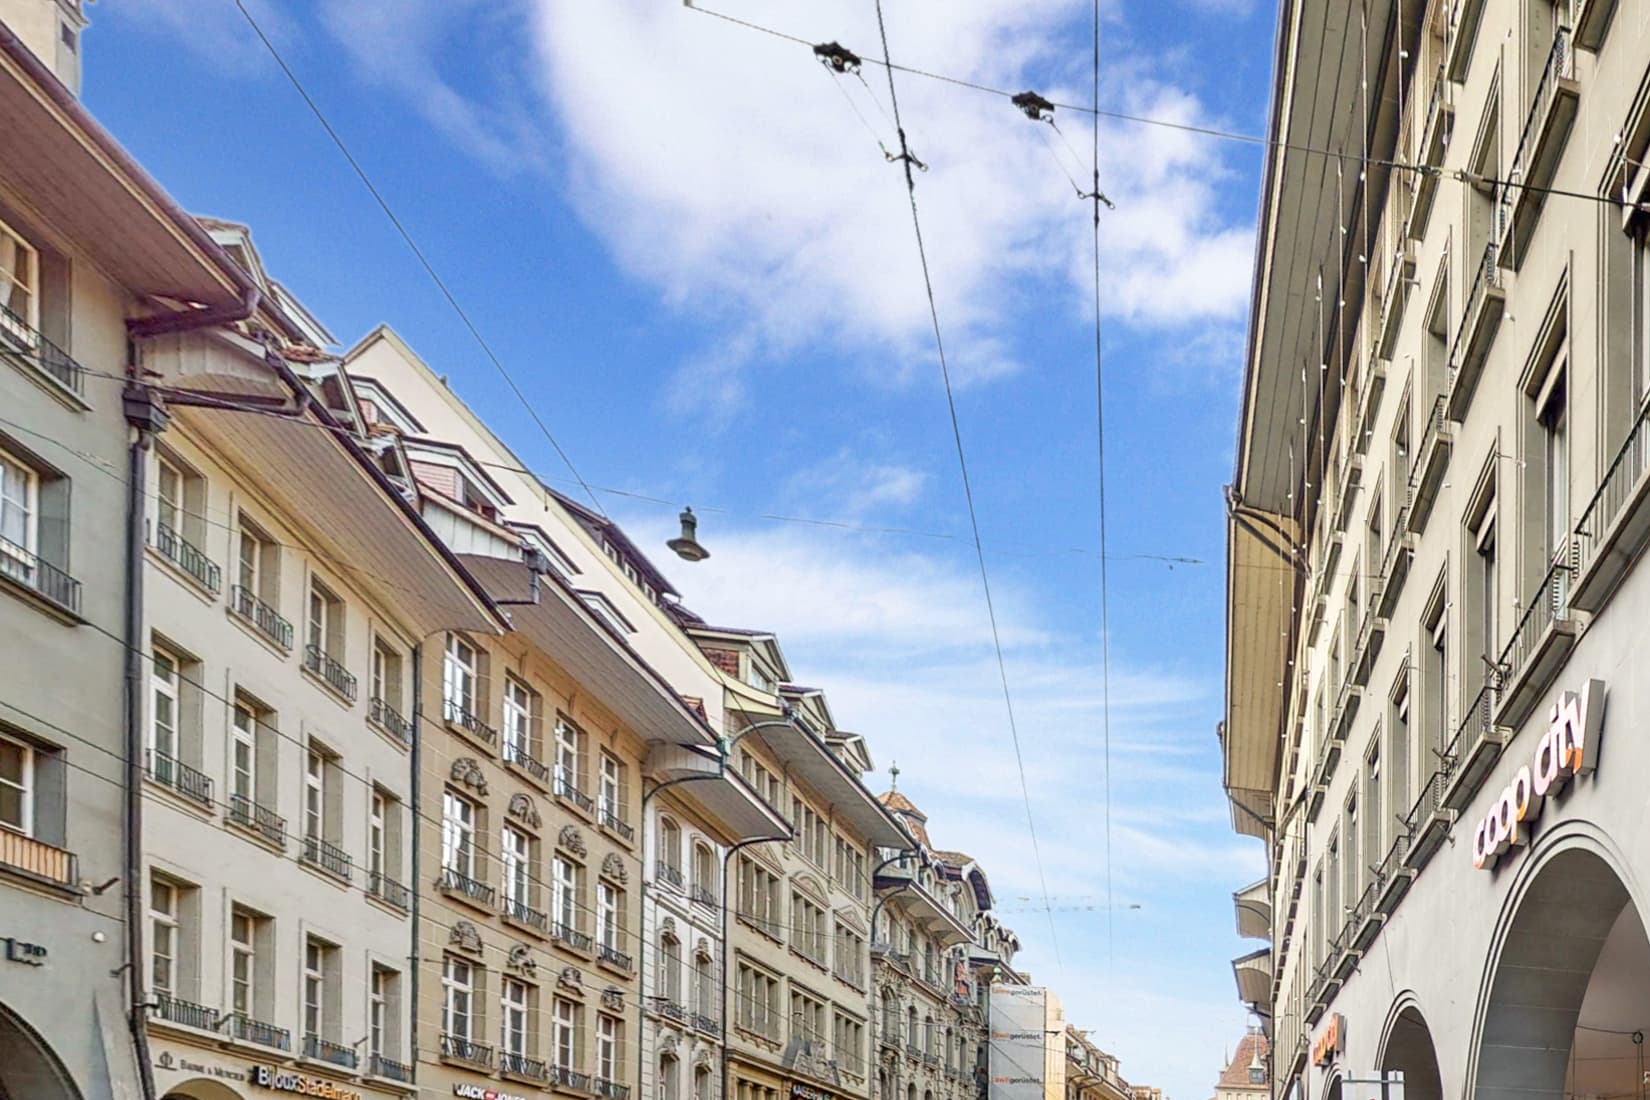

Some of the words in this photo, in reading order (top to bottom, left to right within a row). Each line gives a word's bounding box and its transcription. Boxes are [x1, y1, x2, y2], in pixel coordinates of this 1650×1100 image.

[1473, 764, 1535, 870] coop
[1534, 678, 1600, 796] city
[456, 1084, 485, 1100] JACK
